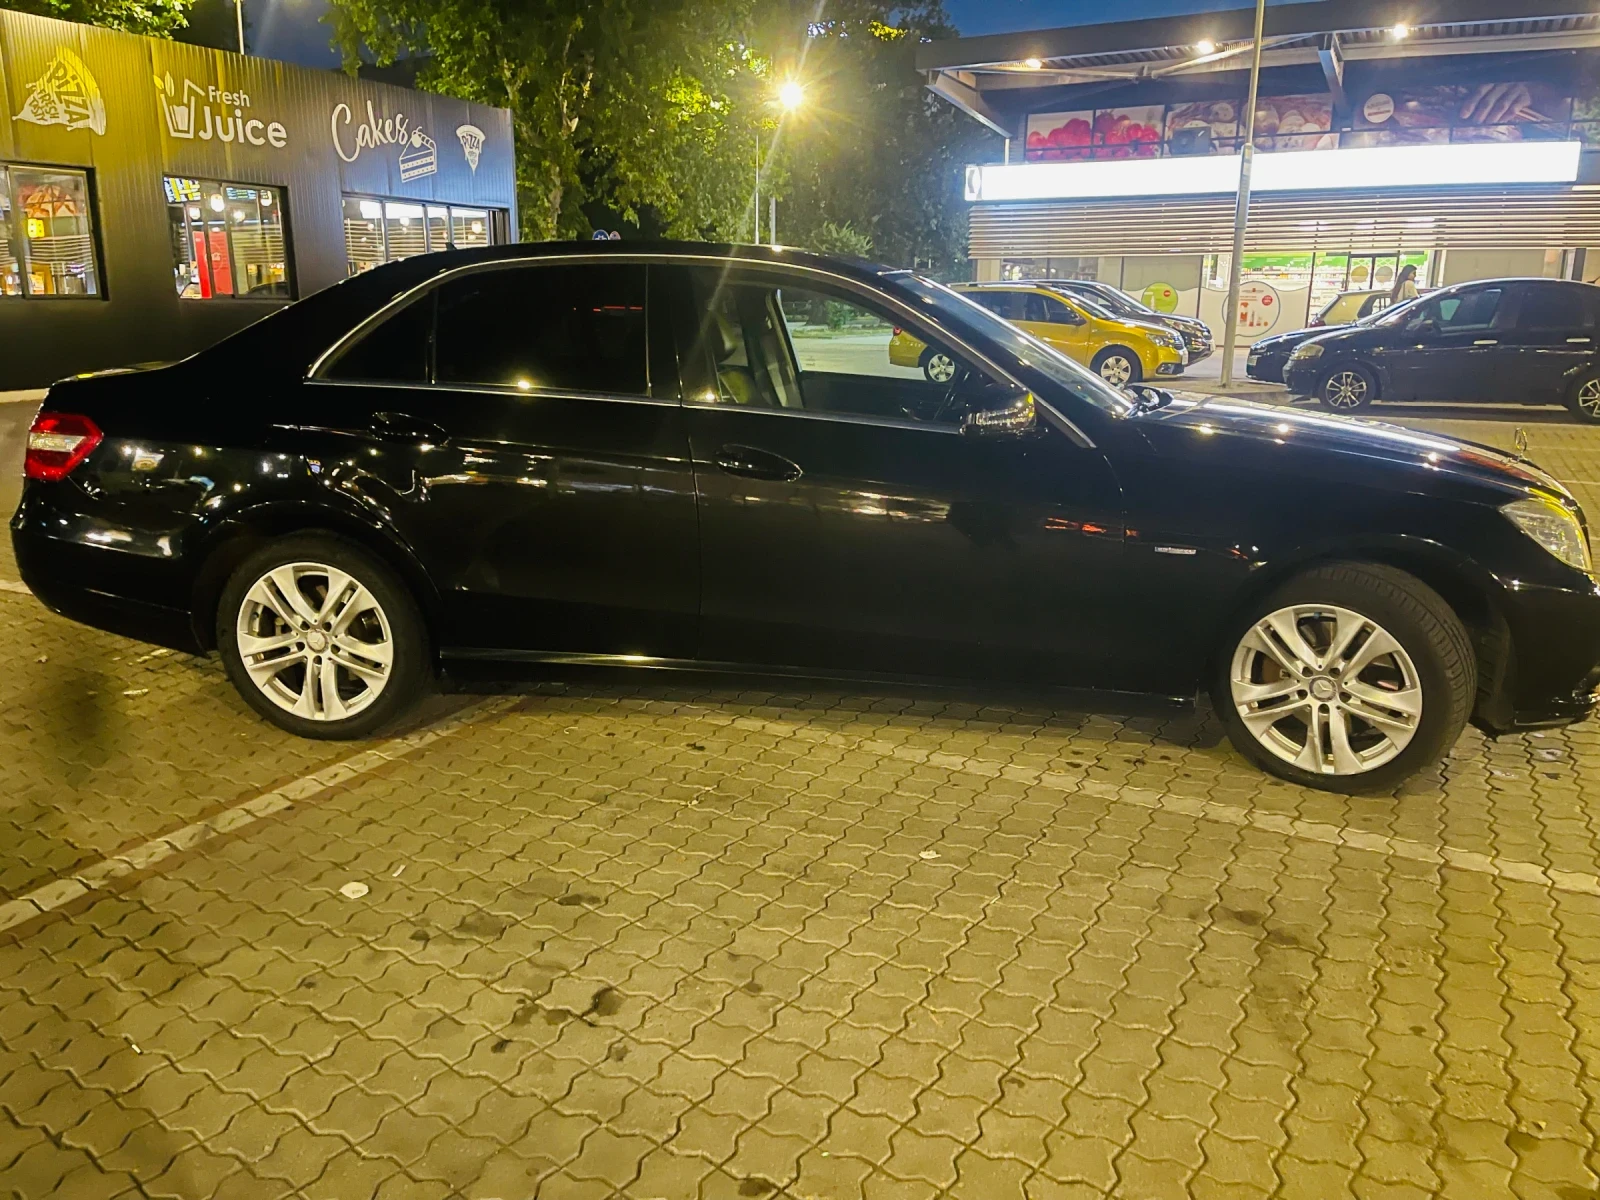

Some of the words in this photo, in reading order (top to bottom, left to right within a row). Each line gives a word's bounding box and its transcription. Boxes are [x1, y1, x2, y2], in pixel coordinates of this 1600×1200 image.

[29, 96, 48, 121] TASTY
[37, 88, 60, 119] FRESH
[208, 85, 250, 107] Fresh
[198, 105, 287, 148] Juice
[331, 100, 409, 162] Cakes
